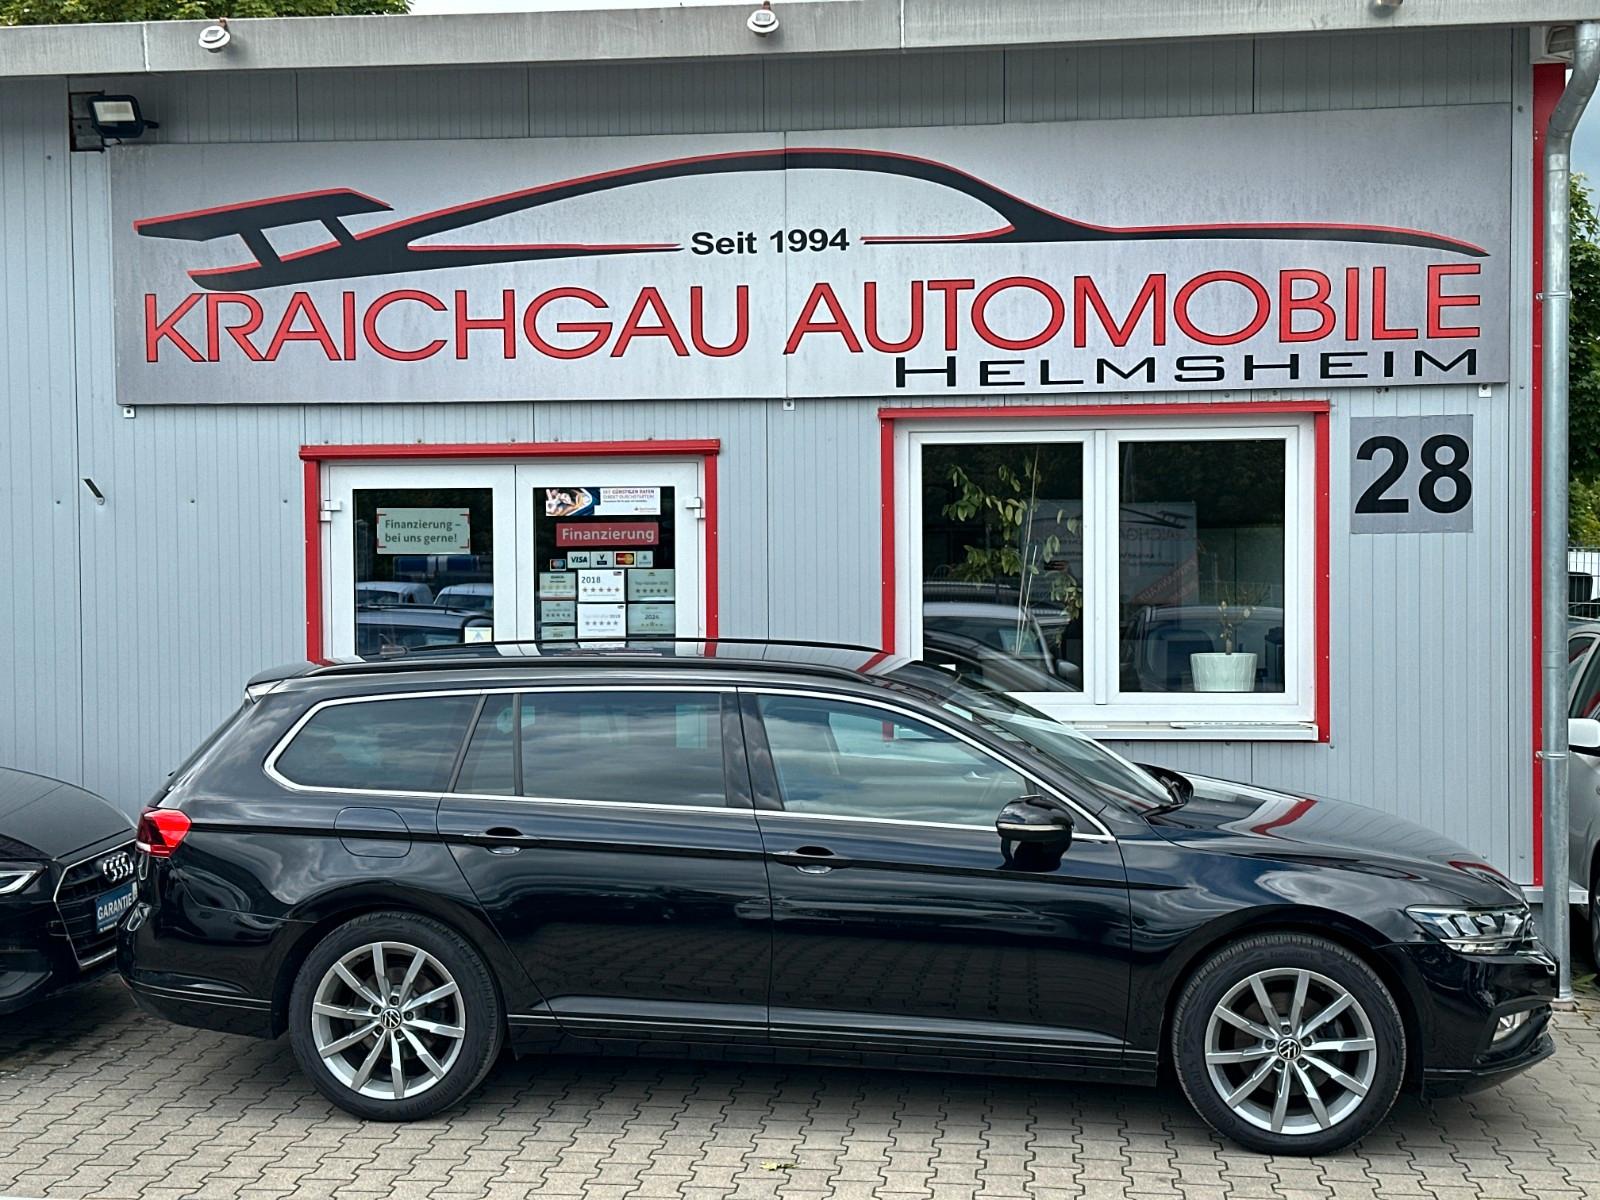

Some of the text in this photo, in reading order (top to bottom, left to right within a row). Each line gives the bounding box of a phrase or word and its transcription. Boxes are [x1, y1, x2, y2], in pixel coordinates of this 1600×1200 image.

[691, 228, 850, 255] Seit 1994
[144, 263, 1482, 363] KRAICHGAU AUTOMOBILE
[896, 348, 1478, 388] HELMSHEIM
[1354, 433, 1473, 515] 28
[384, 519, 452, 531] Finanzierung
[562, 528, 654, 543] Finanzierung
[385, 533, 457, 545] bei uns gerne!
[581, 576, 601, 584] 2018
[97, 892, 132, 920] GARANTIE
